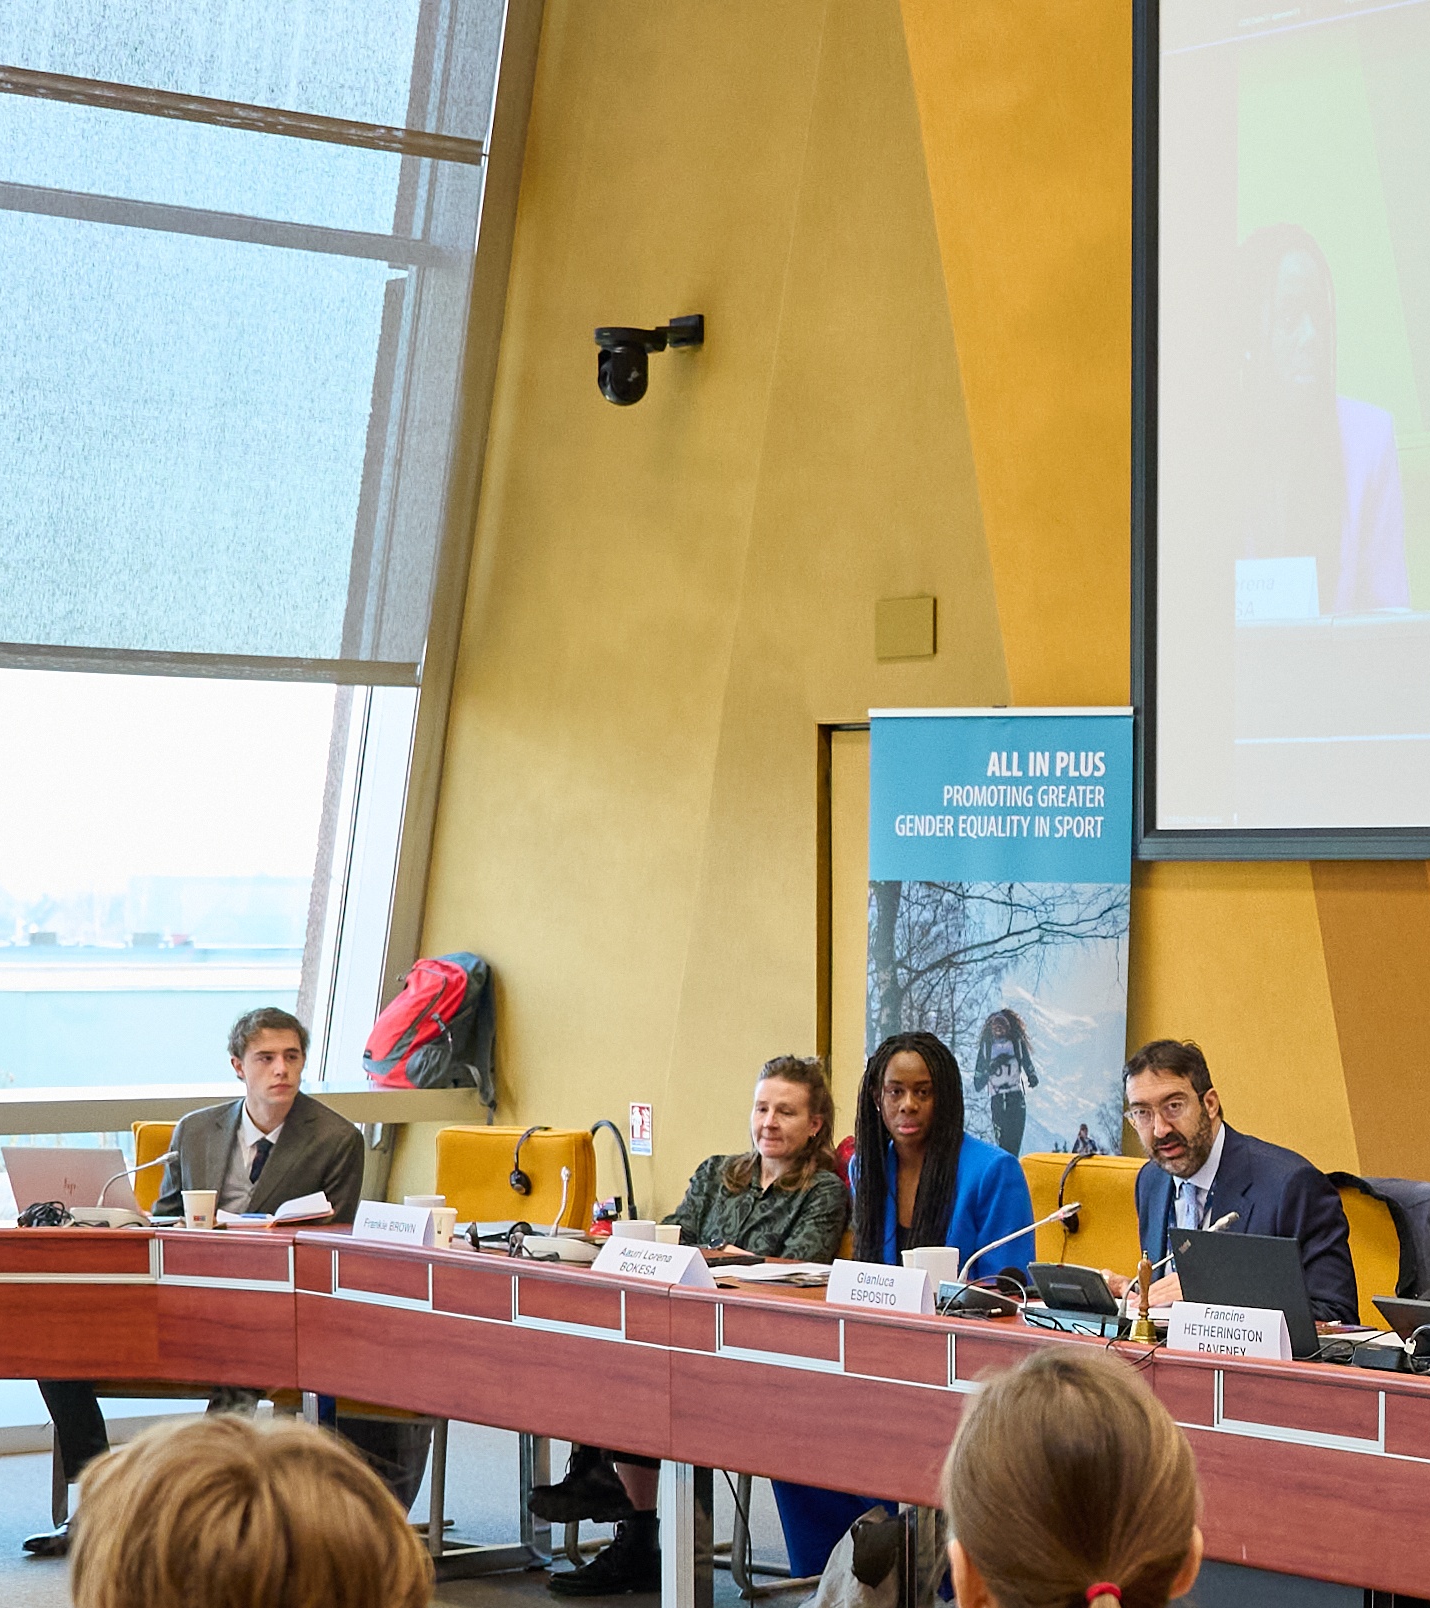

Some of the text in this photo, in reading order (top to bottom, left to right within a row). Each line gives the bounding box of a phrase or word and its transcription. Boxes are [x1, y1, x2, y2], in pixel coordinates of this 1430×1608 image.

[986, 750, 1107, 778] ALL IN PLUS
[943, 785, 1105, 808] PROMOTING GREATER
[895, 815, 1103, 839] GENDER EQUALITY IN SPORT
[389, 1221, 416, 1234] BROWN
[643, 1250, 672, 1263] Lorena
[619, 1261, 656, 1276] BOKESA
[857, 1272, 894, 1288] Gianluca
[850, 1288, 896, 1306] ESPOSITO
[1204, 1307, 1245, 1323] Francine
[1183, 1323, 1263, 1344] HETHERINGTON
